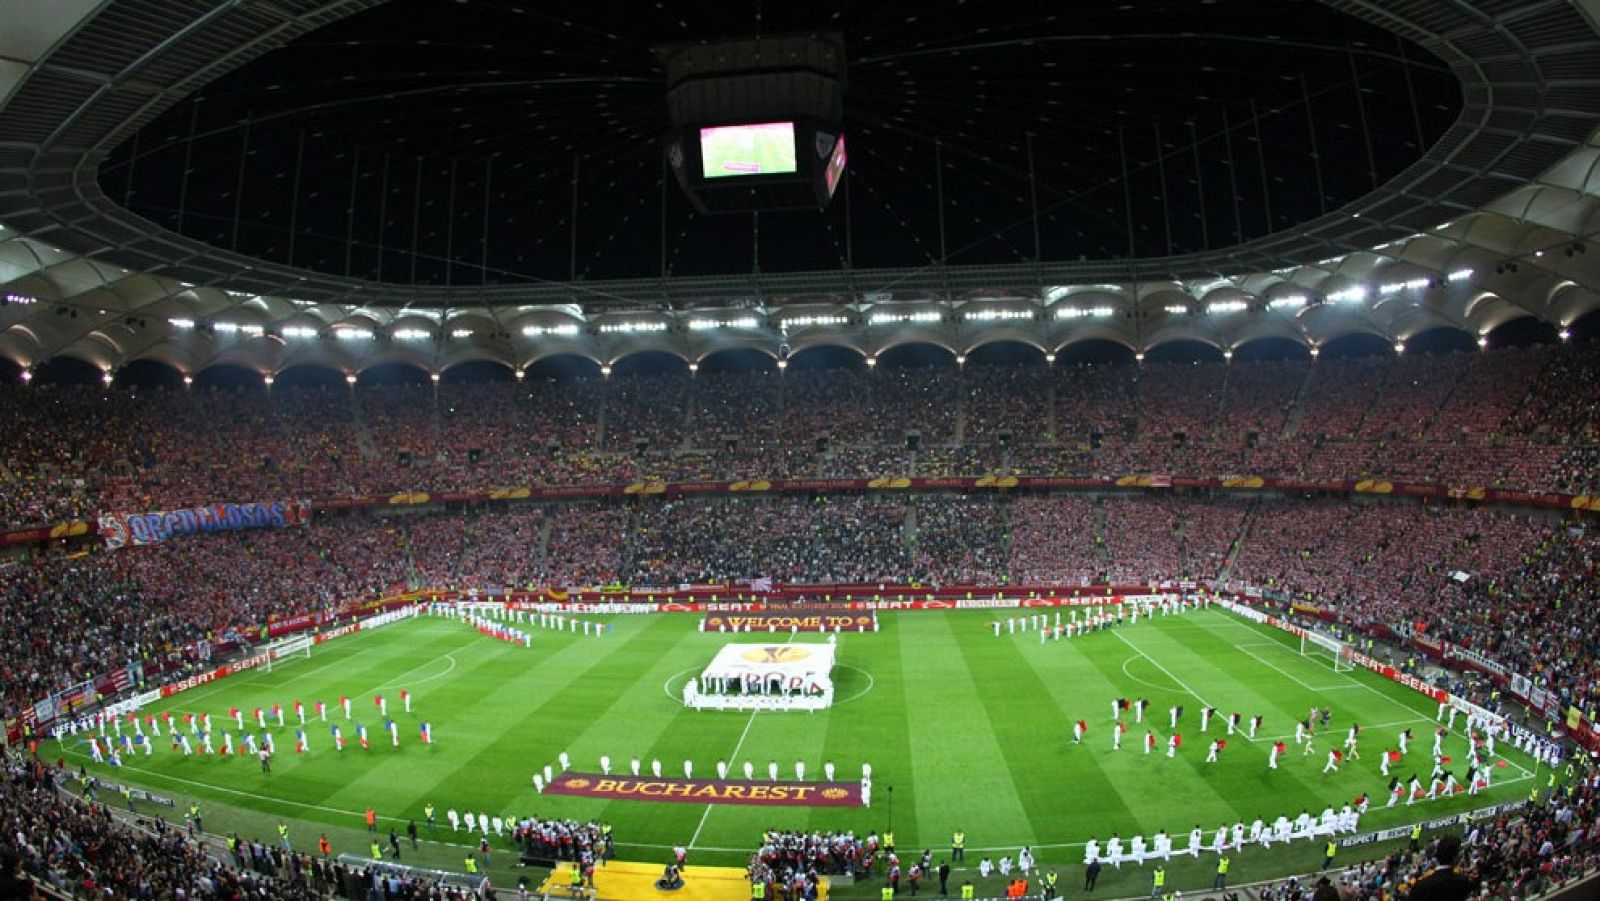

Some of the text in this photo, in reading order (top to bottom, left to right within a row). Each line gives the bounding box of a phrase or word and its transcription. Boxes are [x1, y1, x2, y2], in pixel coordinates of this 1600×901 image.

[708, 602, 752, 611] SEAT
[866, 600, 912, 609] SEAT
[727, 616, 853, 627] WELCOME TO
[326, 624, 355, 640] SEAT
[233, 653, 269, 671] SEAT
[1354, 651, 1386, 673] SEAT
[178, 670, 216, 691] SEAT
[1401, 674, 1438, 698] SEAT
[592, 780, 816, 799] BUCHAREST
